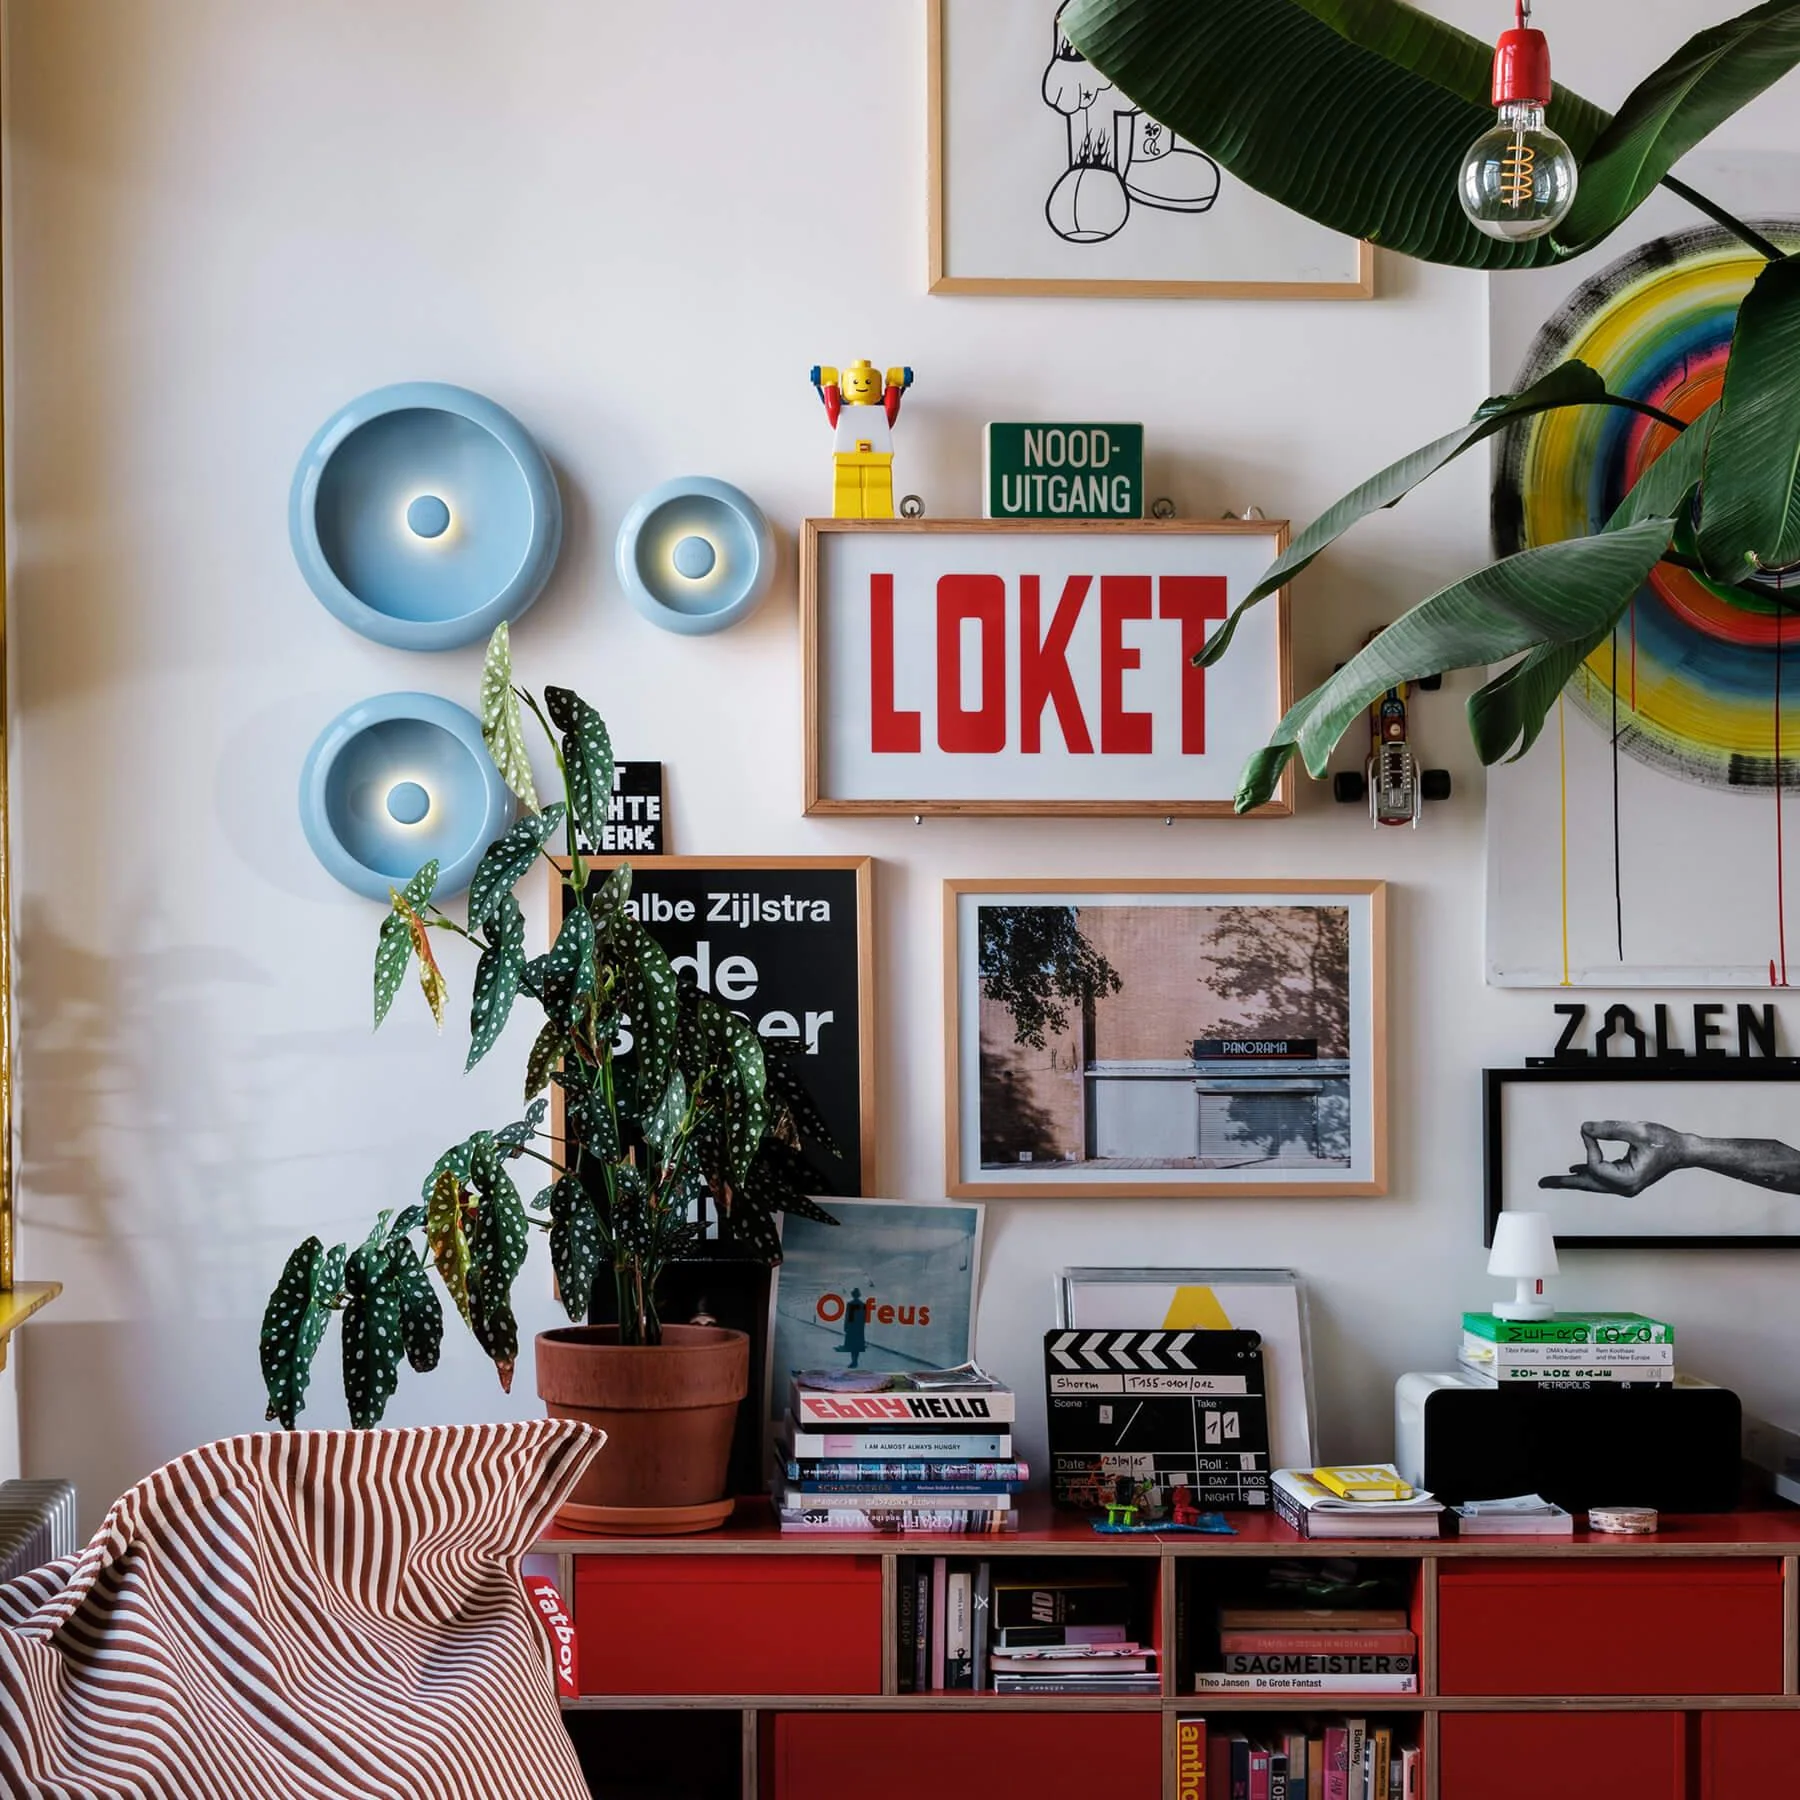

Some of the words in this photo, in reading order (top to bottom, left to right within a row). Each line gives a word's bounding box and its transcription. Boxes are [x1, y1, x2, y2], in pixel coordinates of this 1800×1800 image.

[1024, 430, 1120, 468] NOOD-
[1002, 474, 1131, 513] UITGANG
[870, 573, 1227, 755] LOKET
[573, 796, 660, 820] HTE
[593, 893, 696, 922] albe
[706, 893, 831, 928] Zijlstra
[669, 941, 759, 1000] de
[1222, 1041, 1287, 1054] PANORAMA
[816, 1293, 930, 1326] Orfeus
[1508, 1327, 1587, 1342] METRO
[1510, 1369, 1538, 1377] NOT
[1543, 1369, 1570, 1377] FOR
[1575, 1369, 1612, 1377] SALE
[1538, 1381, 1590, 1389] METROPOLIS
[906, 1398, 991, 1418] HELLO
[1209, 1476, 1228, 1485] DAY
[1242, 1476, 1266, 1485] MOS
[1205, 1492, 1235, 1502] NIGHT
[534, 1585, 575, 1687] fatboy
[1234, 1656, 1391, 1673] SAGMEISTER
[1200, 1678, 1219, 1687] Theo
[1221, 1679, 1249, 1687] Jansen
[1256, 1679, 1267, 1687] De
[1269, 1679, 1290, 1687] Grote
[1292, 1679, 1322, 1687] Fantast
